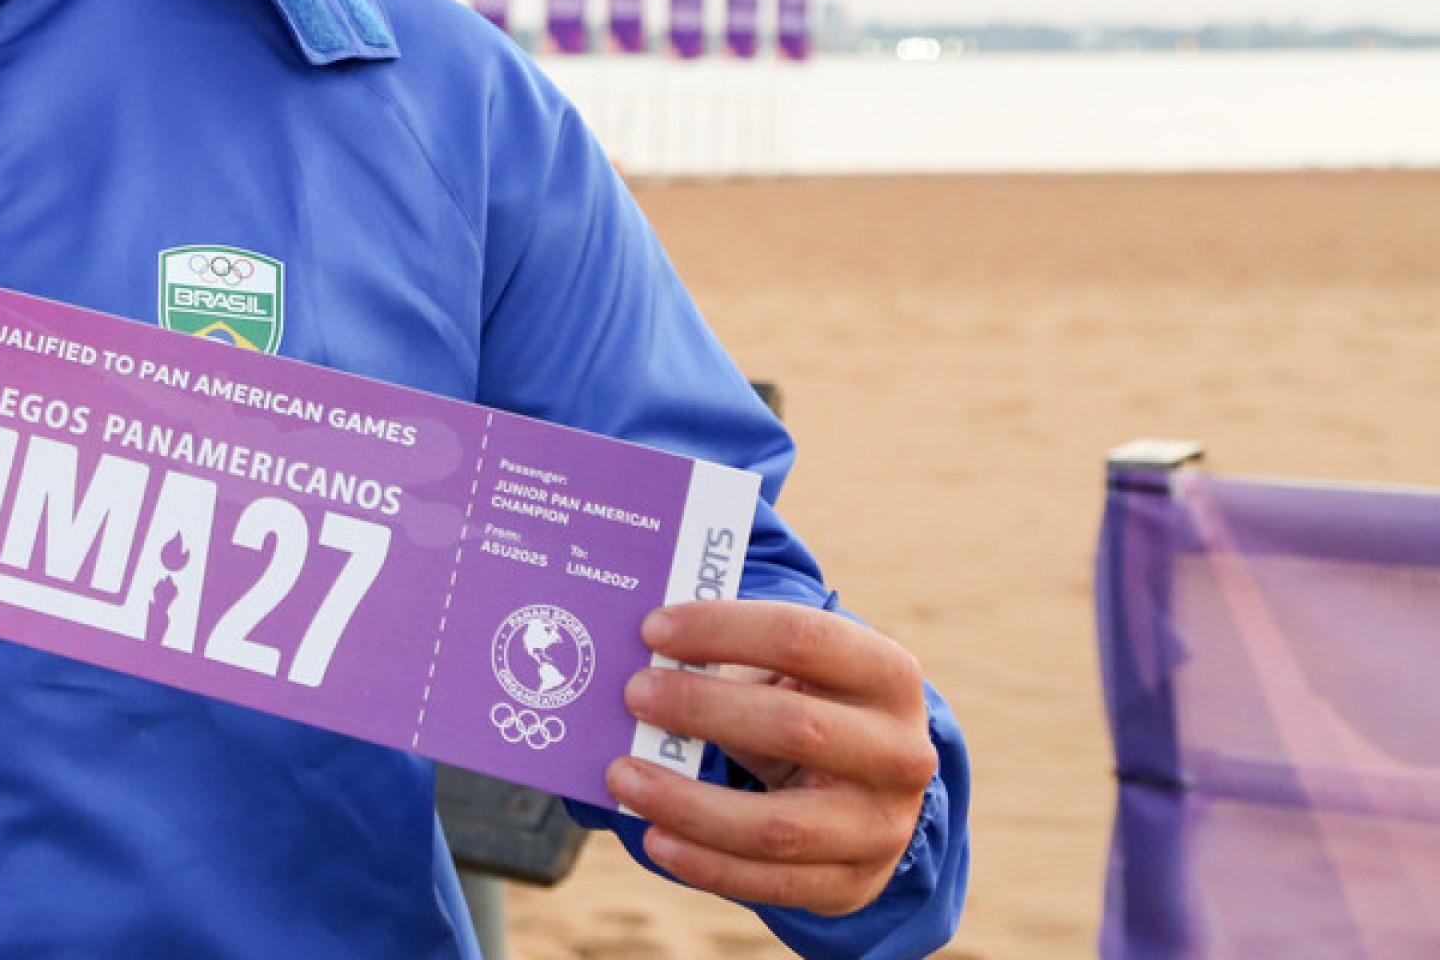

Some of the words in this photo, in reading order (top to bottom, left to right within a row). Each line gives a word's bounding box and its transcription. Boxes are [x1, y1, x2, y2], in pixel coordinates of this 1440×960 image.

[174, 287, 267, 315] BRASIL
[103, 350, 135, 374] TO
[139, 360, 190, 389] PAN
[193, 372, 325, 423] AMERICAN
[328, 407, 418, 447] GAMES
[103, 414, 403, 516] PANAMERICANOS
[491, 496, 570, 526] CHAMPION
[493, 480, 548, 503] JUNIOR
[551, 492, 582, 511] PAN
[582, 502, 661, 531] AMERICAN
[480, 540, 549, 568] ASU2025
[566, 561, 640, 590] LIMA2027
